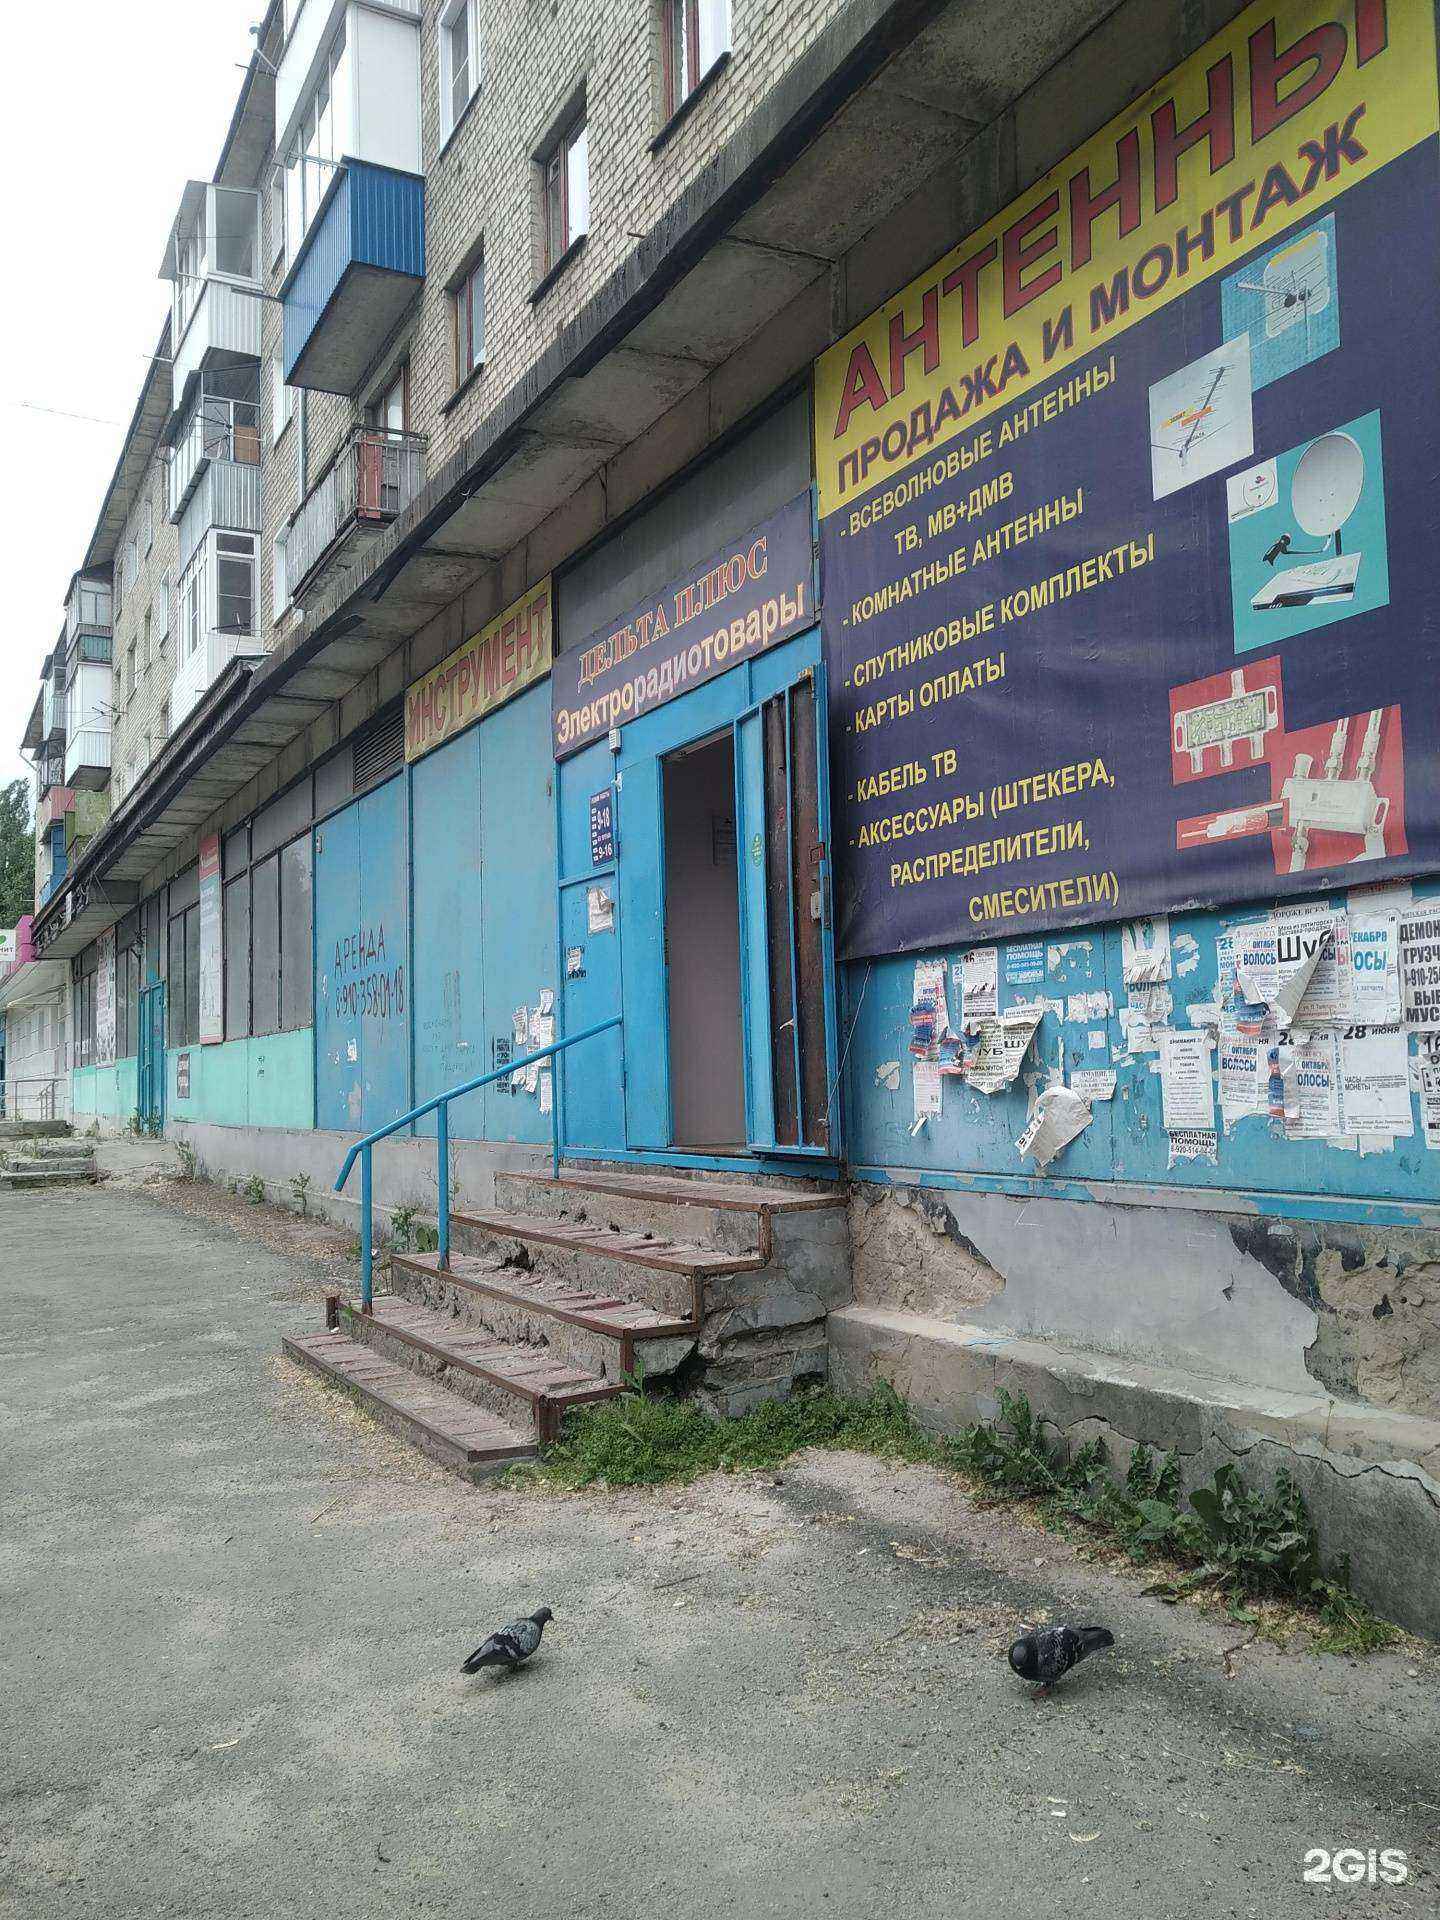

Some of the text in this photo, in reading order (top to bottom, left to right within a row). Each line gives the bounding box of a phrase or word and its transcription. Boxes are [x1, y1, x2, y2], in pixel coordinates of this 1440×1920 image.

[833, 0, 1388, 440] АНТЕННЫ
[837, 102, 1369, 495] ПРОДАЖА И МОНТАЖ
[998, 356, 1116, 448] АНТЕННЫ
[895, 472, 1014, 555] ТВ, МВ+ДМВ
[972, 487, 1083, 566] АНТЕННЫ
[577, 536, 768, 693] ДЕЛЬТА ПЛЮС
[1001, 533, 1154, 624] КОМПЛЕКТЫ
[407, 592, 548, 749] ИНСТРУМЕНТ
[556, 582, 806, 744] Электрорадиотовары
[919, 652, 1006, 707] ОПЛАТЫ
[932, 749, 958, 778] ТВ
[991, 758, 1116, 819] (ШТЕКЕРА,
[890, 820, 1090, 888] РАСПРЕДЕЛИТЕЛИ,
[969, 871, 1120, 922] СМЕСИТЕЛИ)
[1343, 1025, 1367, 1040] 28
